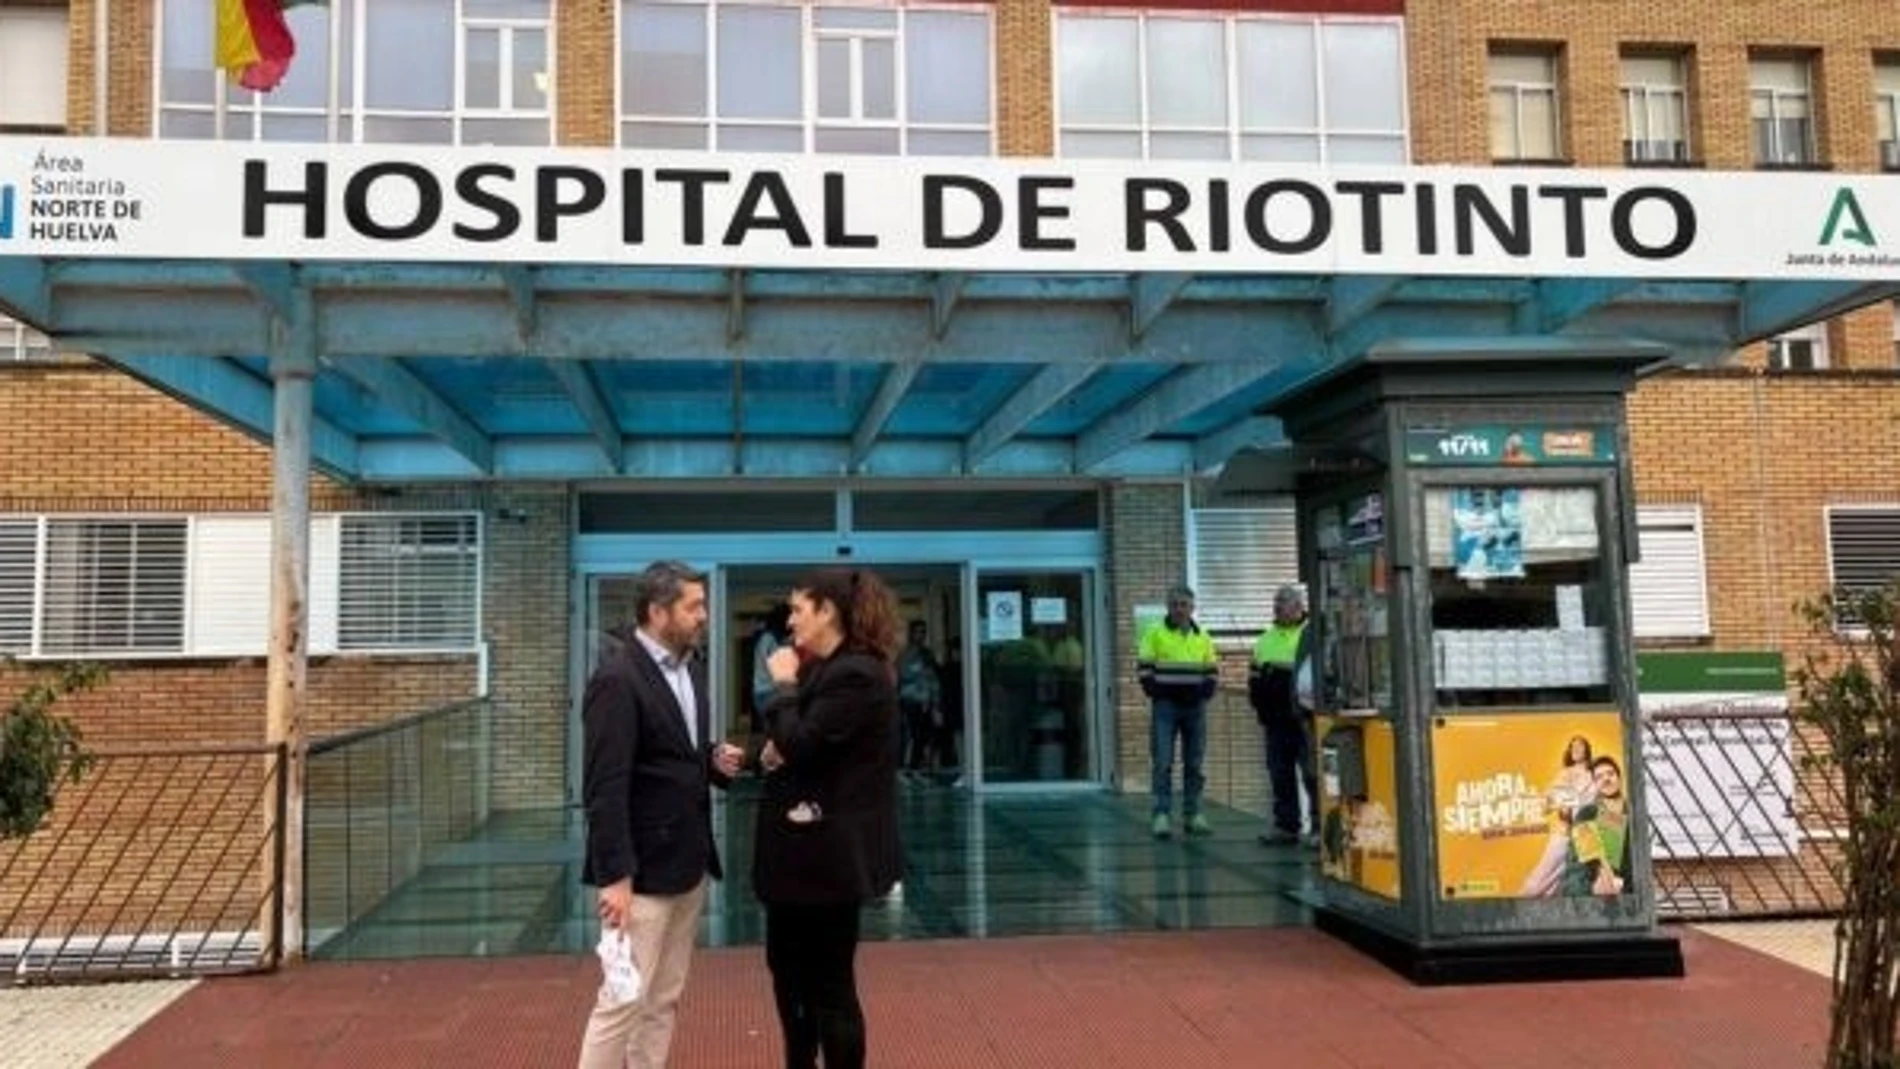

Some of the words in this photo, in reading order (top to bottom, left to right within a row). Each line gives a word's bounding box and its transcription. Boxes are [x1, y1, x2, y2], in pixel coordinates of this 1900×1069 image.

[34, 146, 83, 172] Área
[31, 175, 126, 195] Sanitaria
[31, 199, 106, 218] NORTE
[113, 200, 142, 219] DE
[243, 159, 880, 249] HOSPITAL
[922, 174, 1077, 251] DE
[1125, 178, 1697, 260] RIOTINTO
[31, 222, 118, 241] HUELVA
[1785, 253, 1825, 265] Junta
[1827, 253, 1845, 265] de
[1456, 772, 1526, 806] AHORA
[1443, 797, 1548, 834] SIEMPRE
